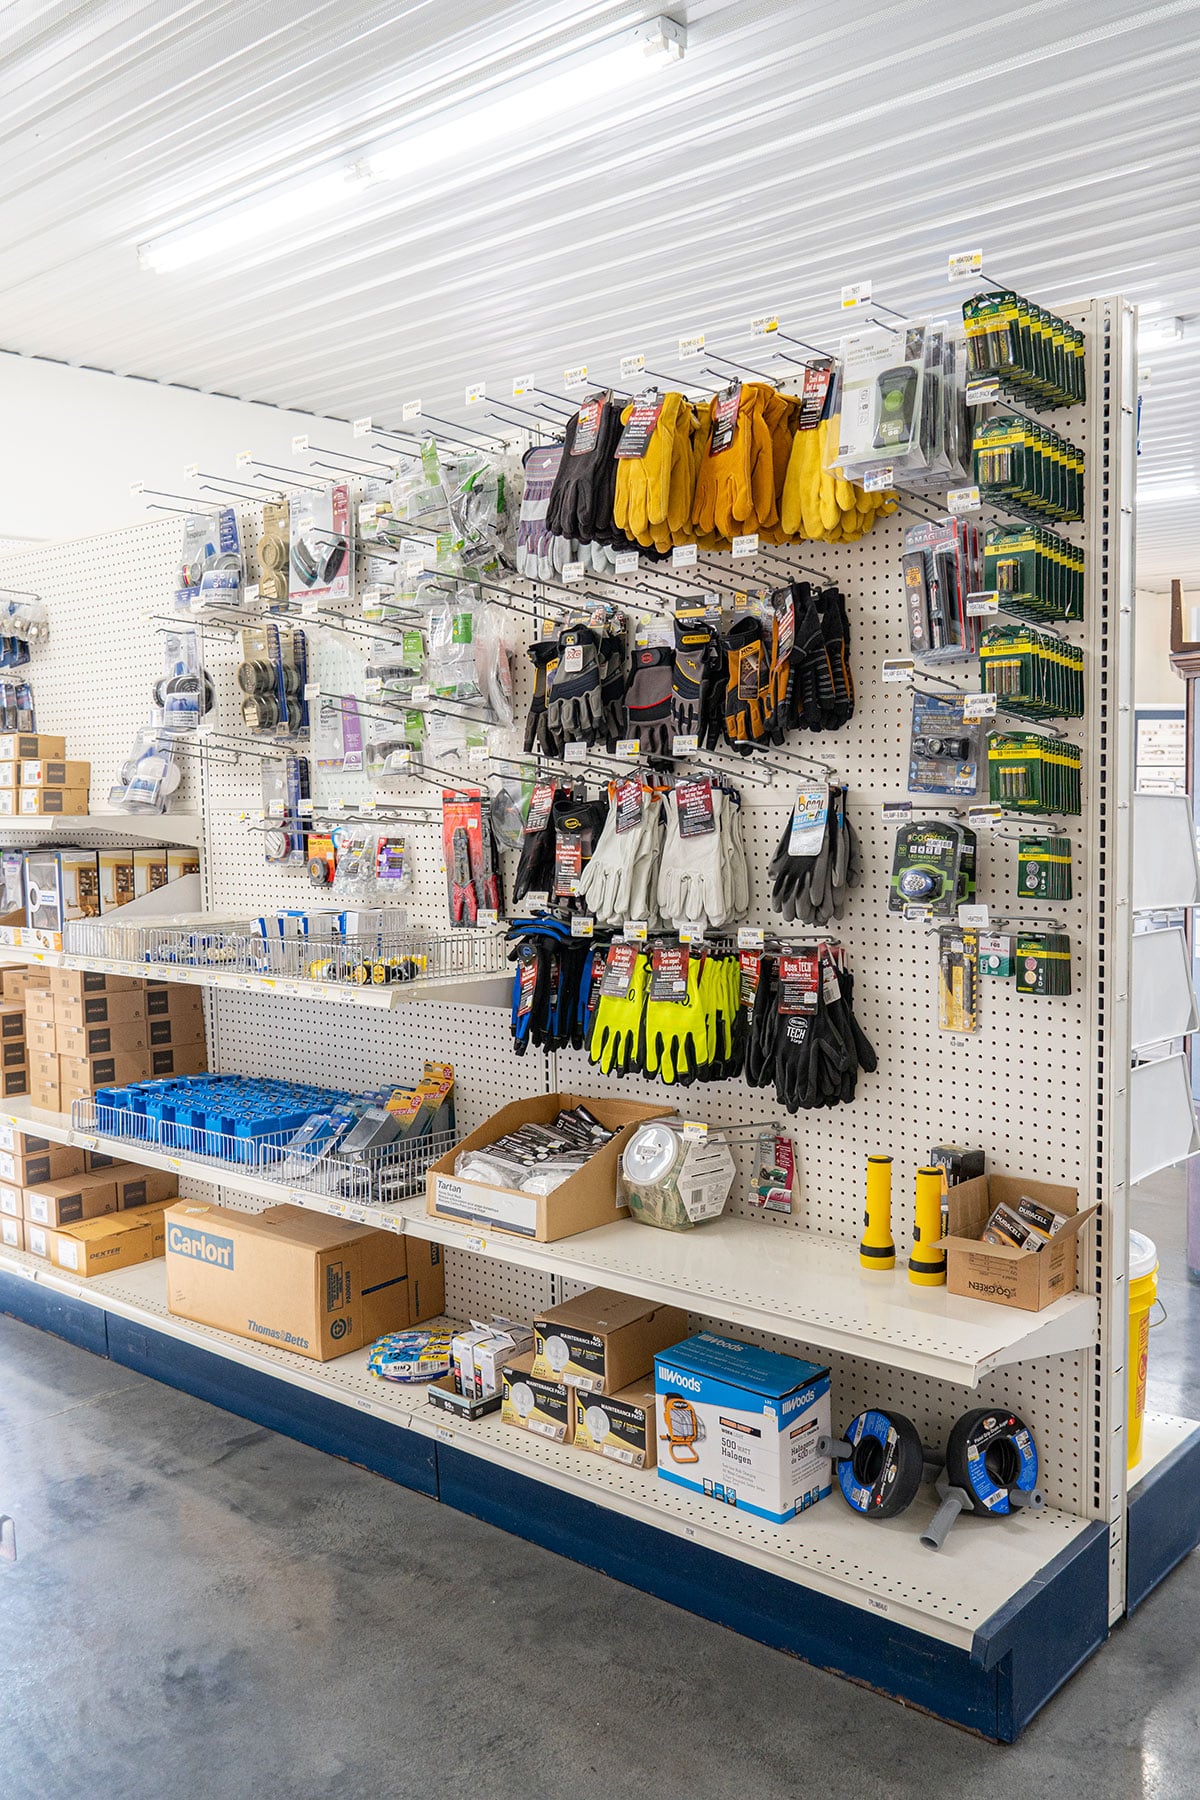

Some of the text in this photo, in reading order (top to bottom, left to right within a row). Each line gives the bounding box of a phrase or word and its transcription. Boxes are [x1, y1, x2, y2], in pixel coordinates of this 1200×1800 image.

[787, 1025, 806, 1039] TECH
[438, 1180, 462, 1193] Tartan
[1018, 1206, 1047, 1225] DURACELL
[995, 1214, 1021, 1239] DURACELL
[90, 1247, 121, 1259] DEXTER
[168, 1228, 231, 1266] Carlon
[560, 1333, 590, 1344] MAINTENANCE
[698, 1334, 745, 1352] Woods
[526, 1380, 554, 1393] MAINTENANCE
[658, 1366, 702, 1393] Woods
[782, 1388, 816, 1415] Woods
[601, 1404, 631, 1417] MAINTENANCE
[721, 1437, 736, 1450] 500
[721, 1446, 752, 1465] Halogen
